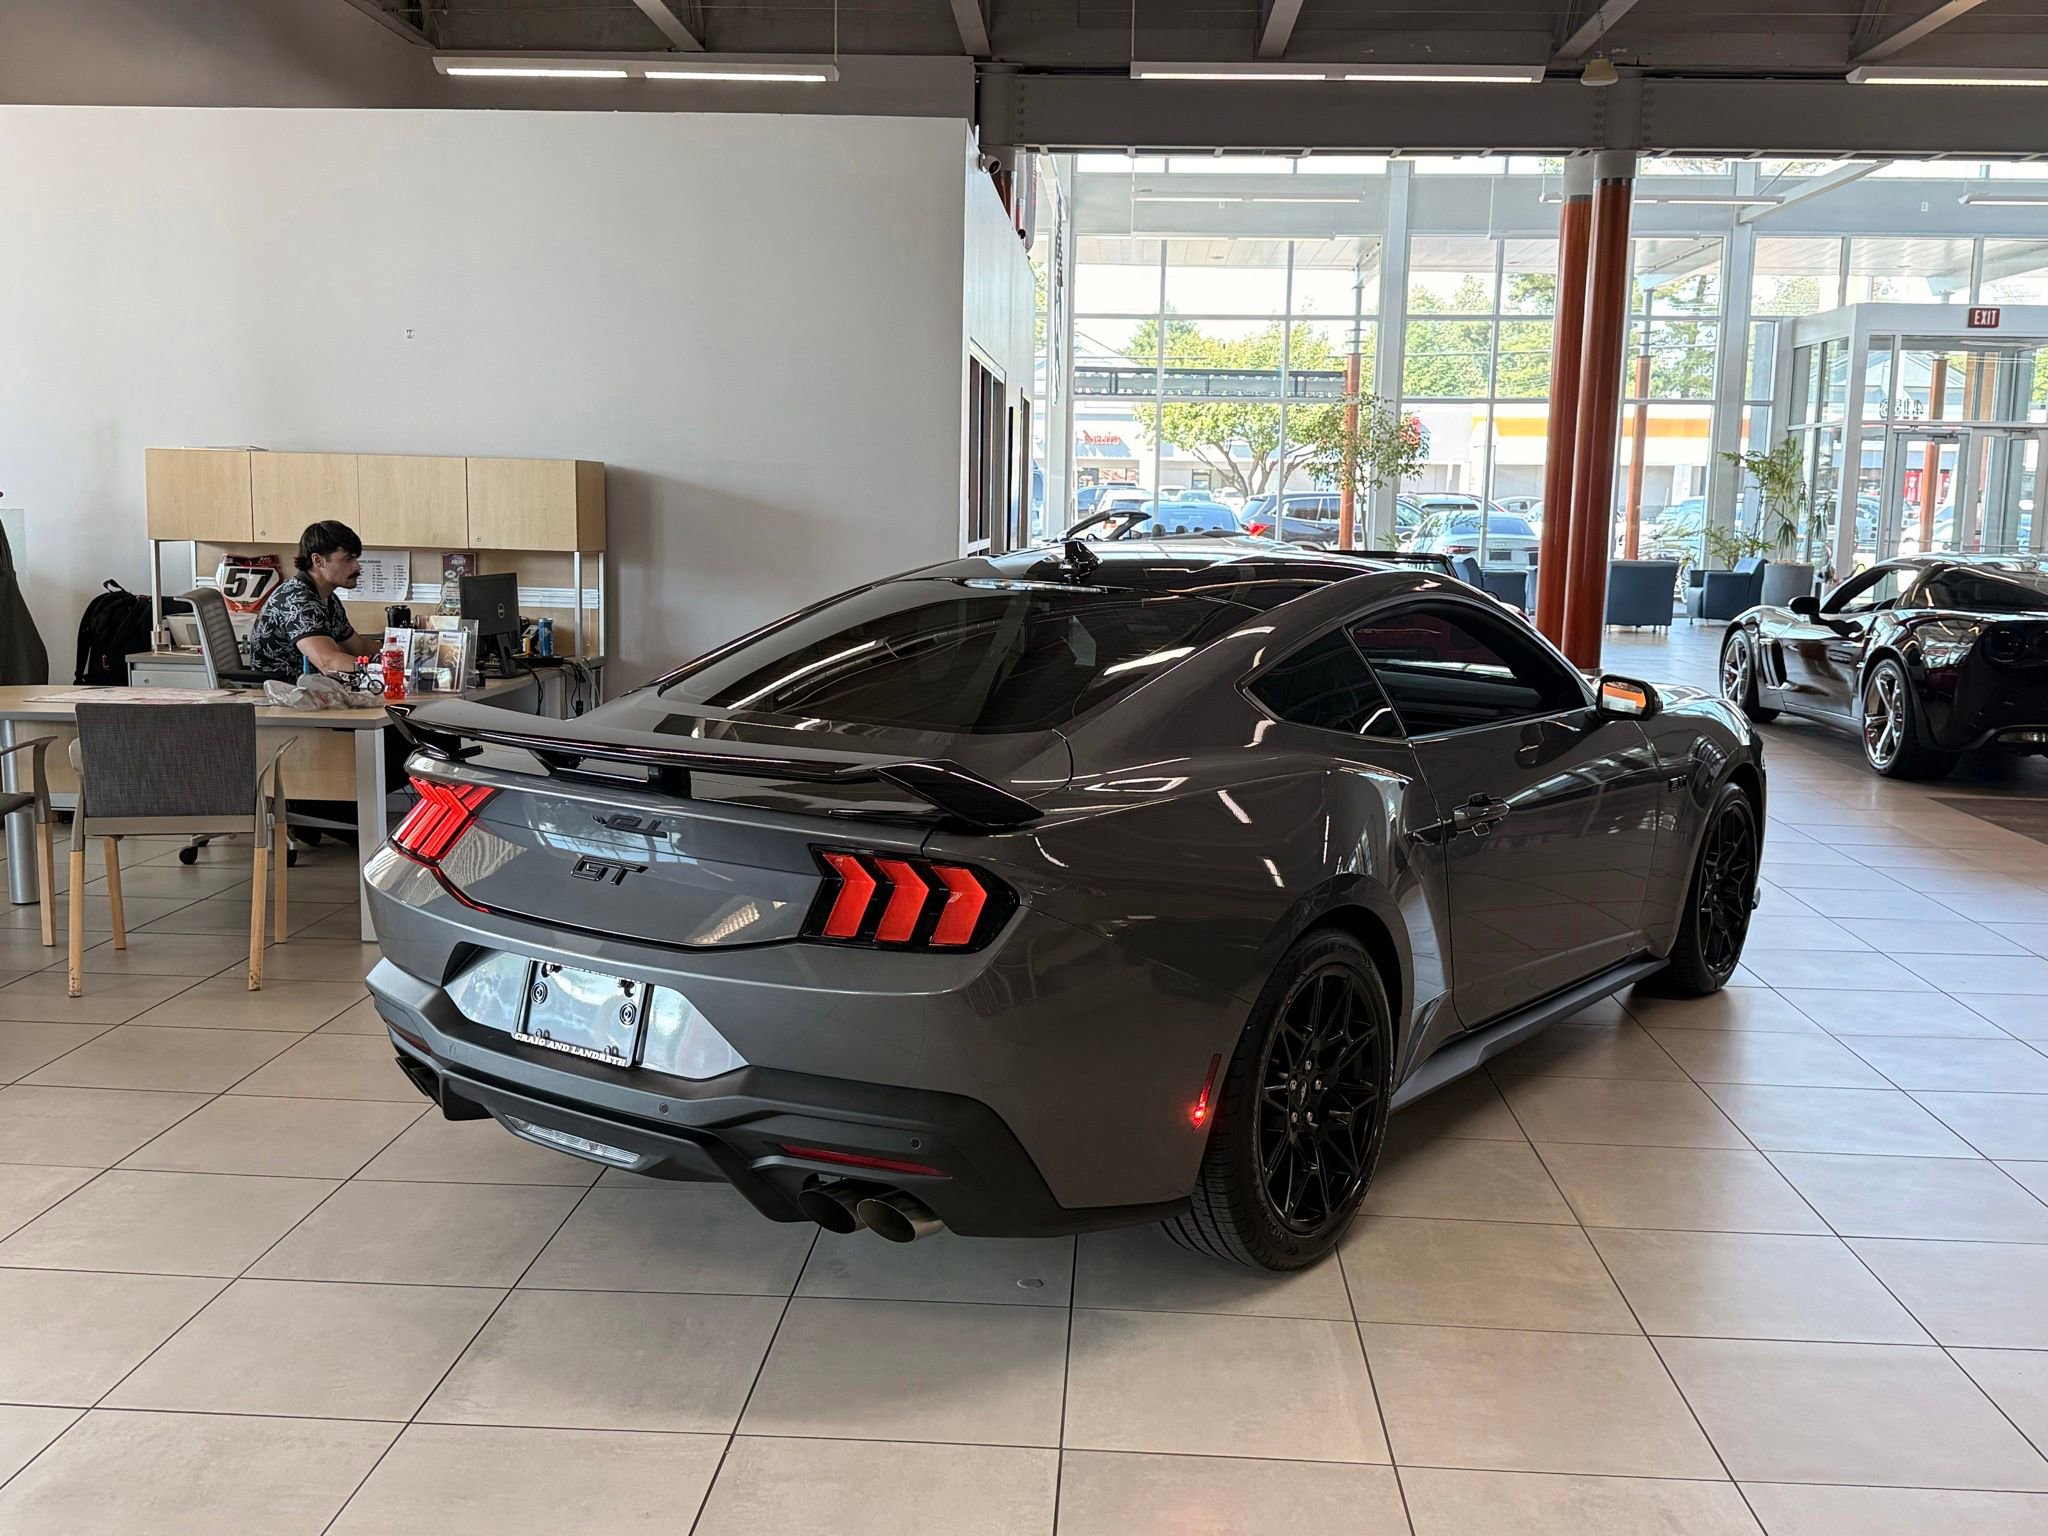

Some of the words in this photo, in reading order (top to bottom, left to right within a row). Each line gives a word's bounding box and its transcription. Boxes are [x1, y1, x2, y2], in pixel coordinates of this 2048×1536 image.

[1974, 309, 1998, 326] EXIT
[223, 567, 275, 599] 57
[570, 855, 649, 887] GT
[513, 1032, 546, 1048] CRAIG
[546, 1040, 570, 1054] AND
[570, 1046, 627, 1068] LANDRETH
